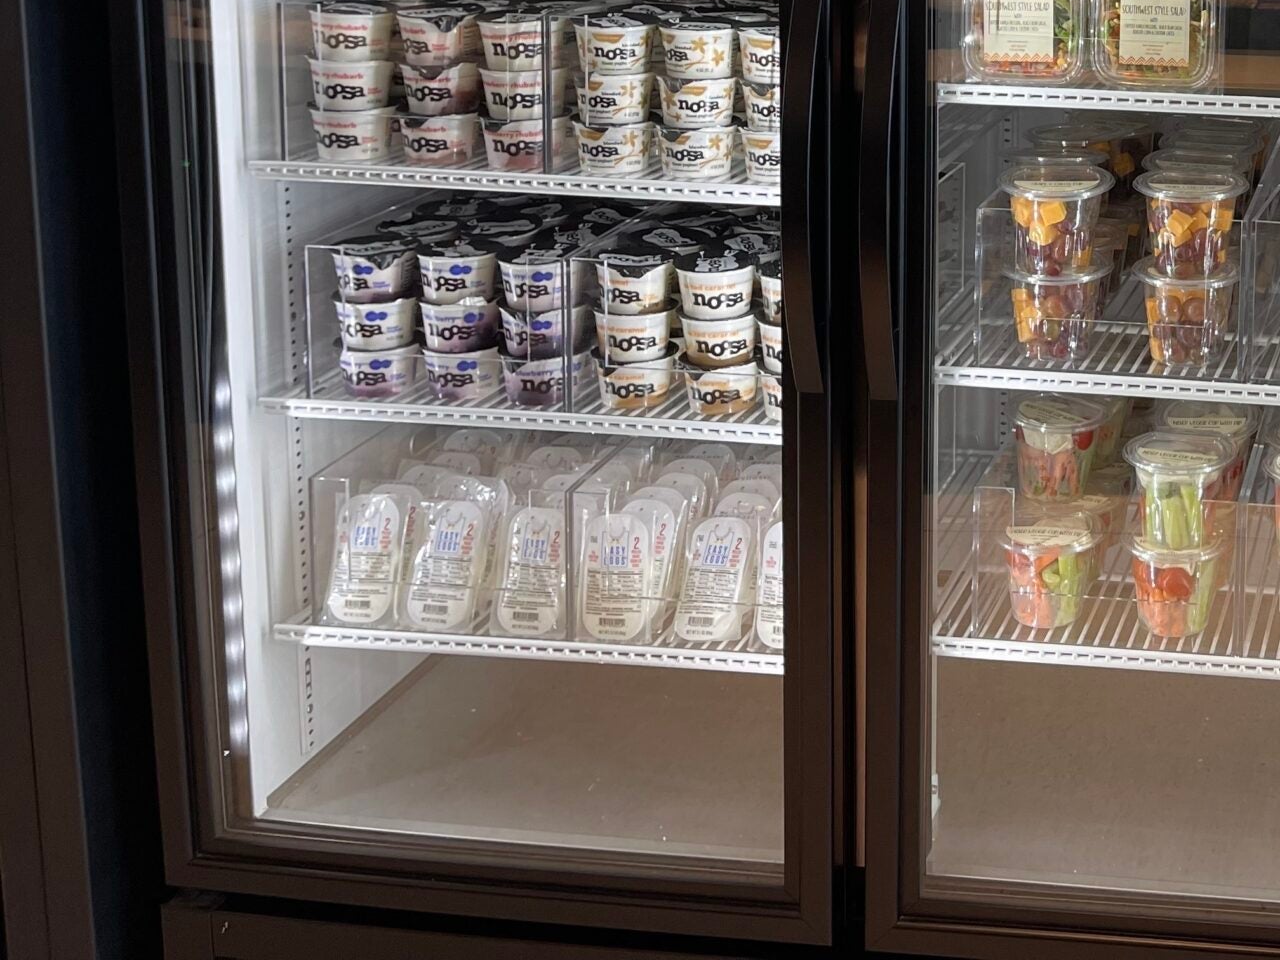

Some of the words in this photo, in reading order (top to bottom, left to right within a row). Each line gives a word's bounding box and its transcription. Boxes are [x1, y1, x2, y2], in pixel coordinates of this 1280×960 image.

[985, 1, 1017, 11] SOUTHWEST
[1019, 2, 1033, 11] STYLE
[1034, 3, 1050, 11] SALAD
[1122, 5, 1153, 15] SOUTHWEST
[1154, 6, 1169, 16] STYLE
[1170, 7, 1186, 16] SALAD
[582, 142, 619, 158] noosa
[666, 146, 704, 162] noosa
[693, 292, 744, 310] noosa
[697, 339, 748, 357] noosa
[604, 380, 654, 398] noosa
[384, 518, 391, 530] 2
[466, 523, 474, 537] 2
[659, 523, 667, 536] 2
[439, 531, 459, 541] EASY
[553, 531, 561, 543] 2
[633, 537, 640, 549] 2
[734, 537, 742, 549] 2
[707, 545, 728, 554] EASY
[705, 556, 727, 564] EGGS
